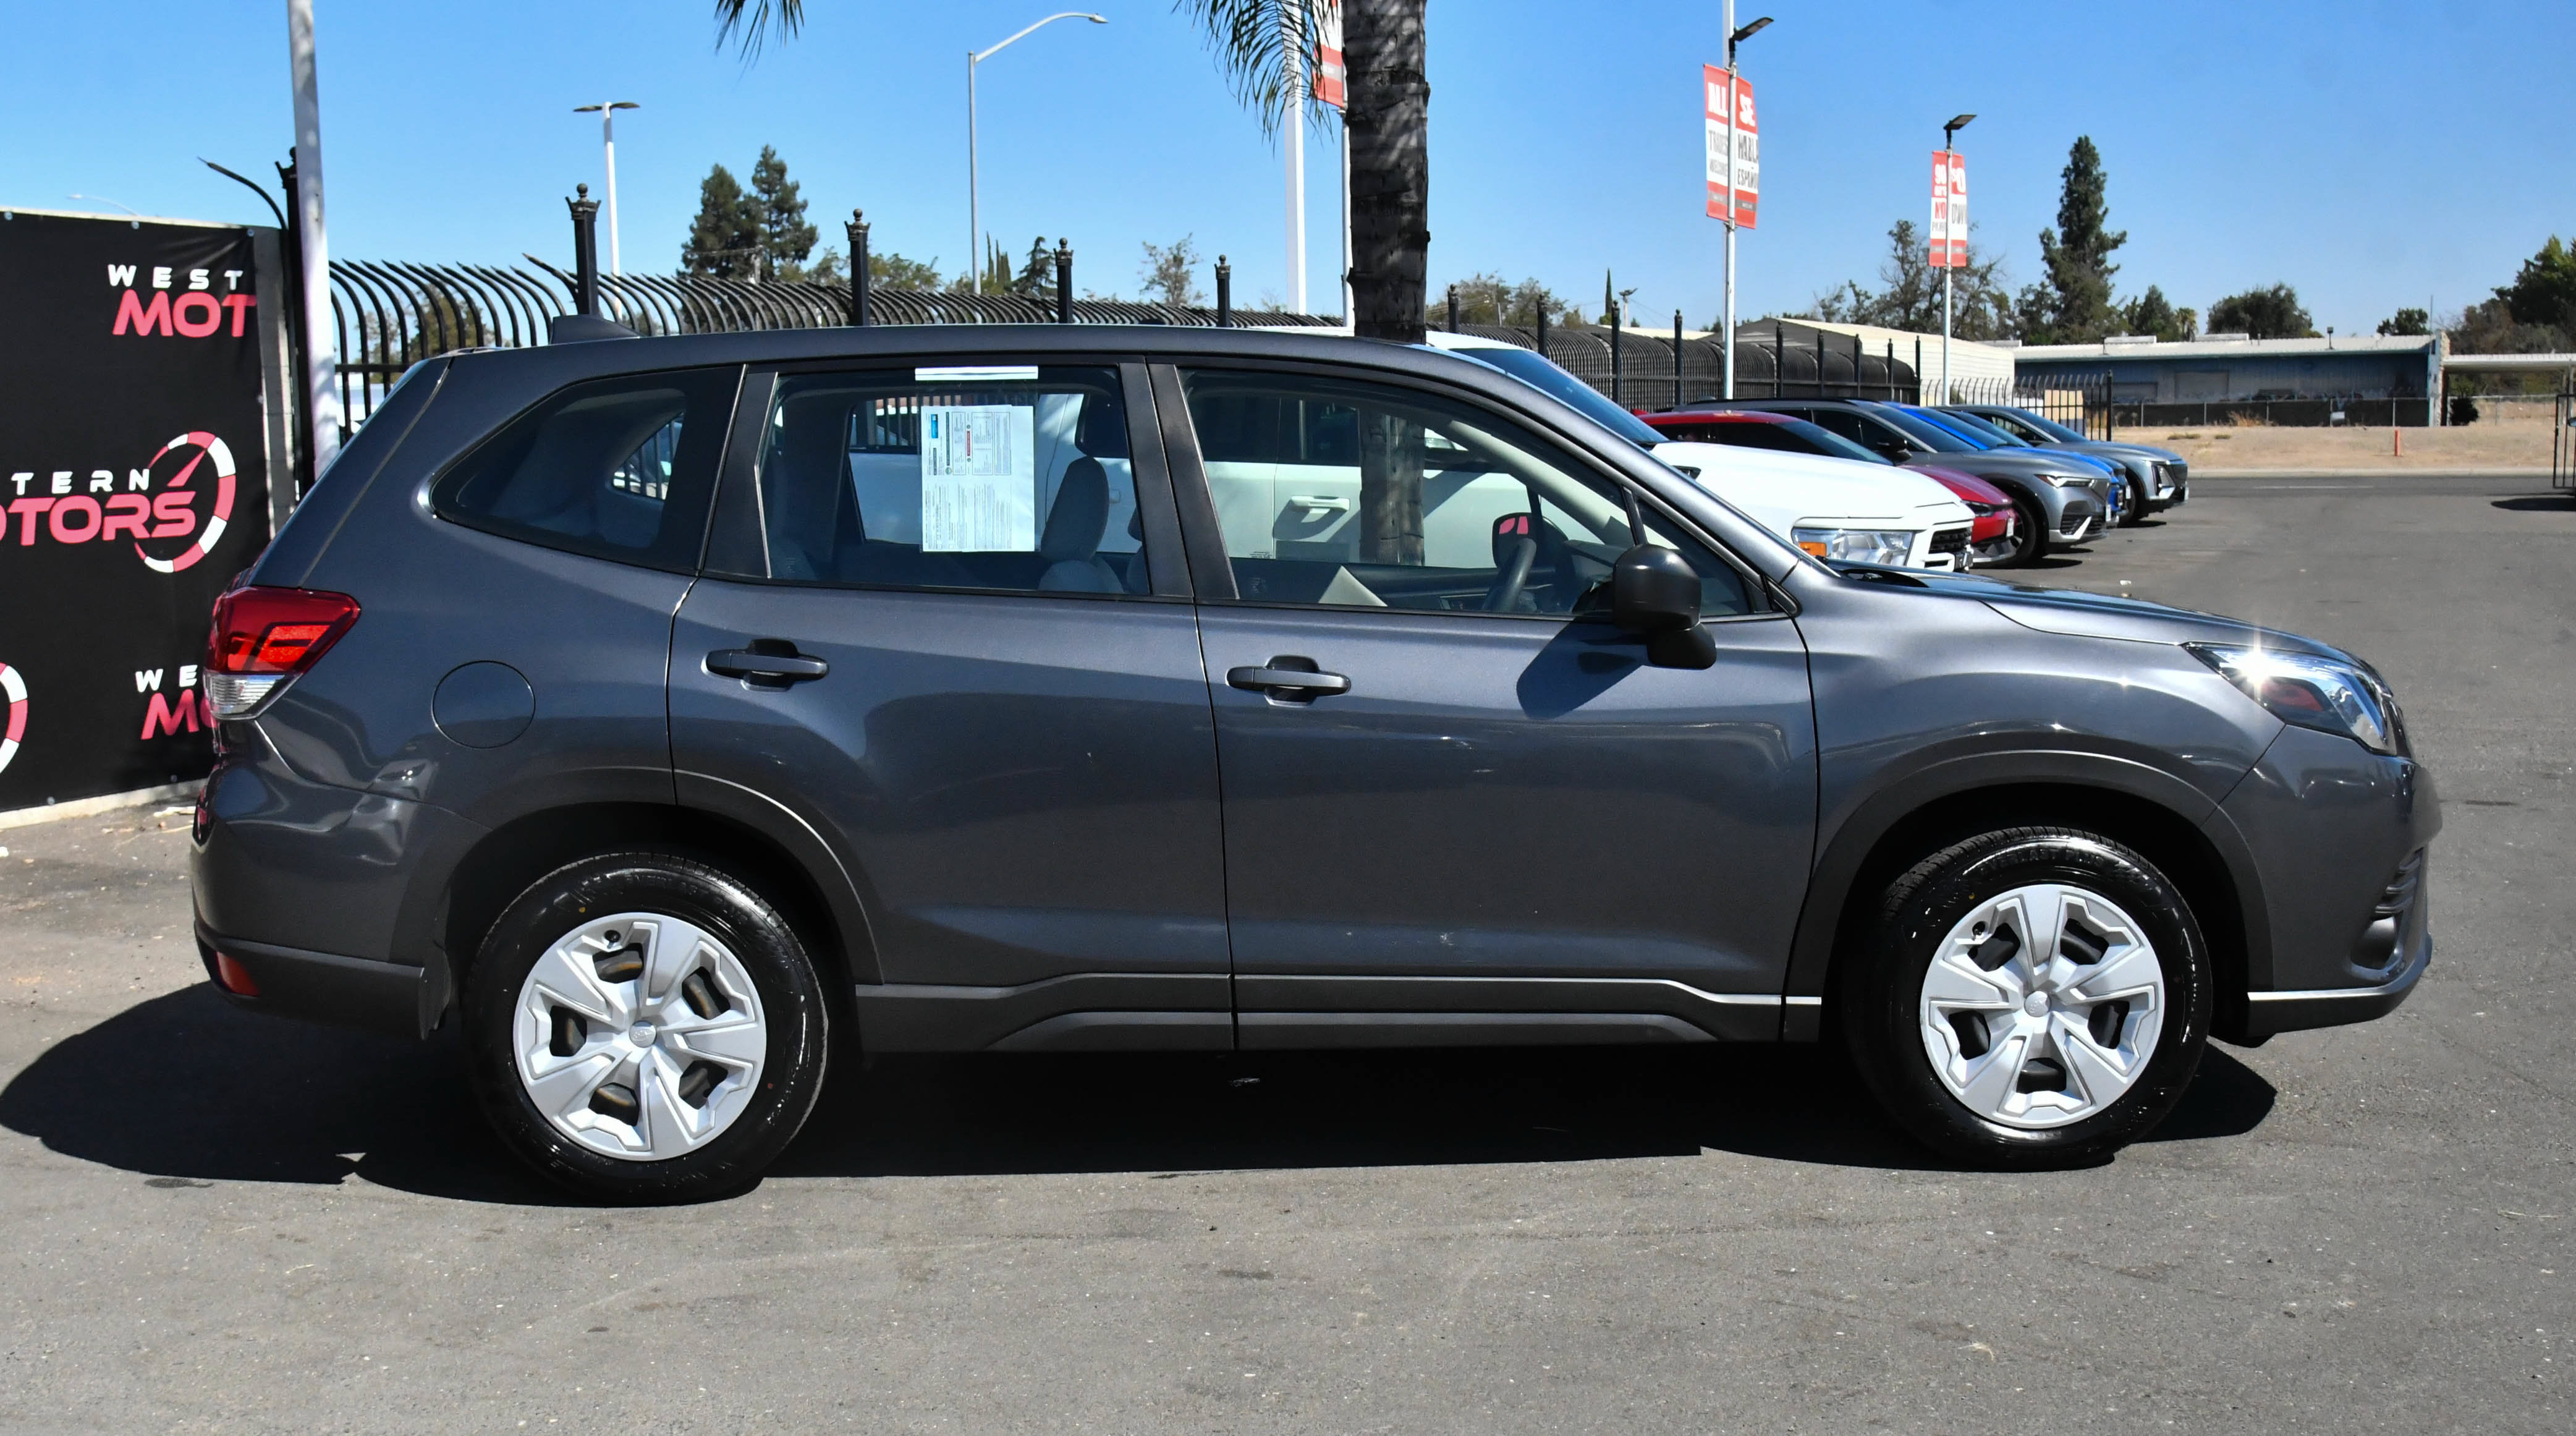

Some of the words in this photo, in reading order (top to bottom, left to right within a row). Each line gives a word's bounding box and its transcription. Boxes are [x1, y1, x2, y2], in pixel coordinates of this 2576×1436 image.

[1739, 93, 1756, 127] SE
[108, 264, 243, 291] WEST
[112, 289, 257, 338] MOT
[11, 469, 150, 495] TERN
[0, 491, 196, 546] TORS
[135, 665, 198, 693] WE
